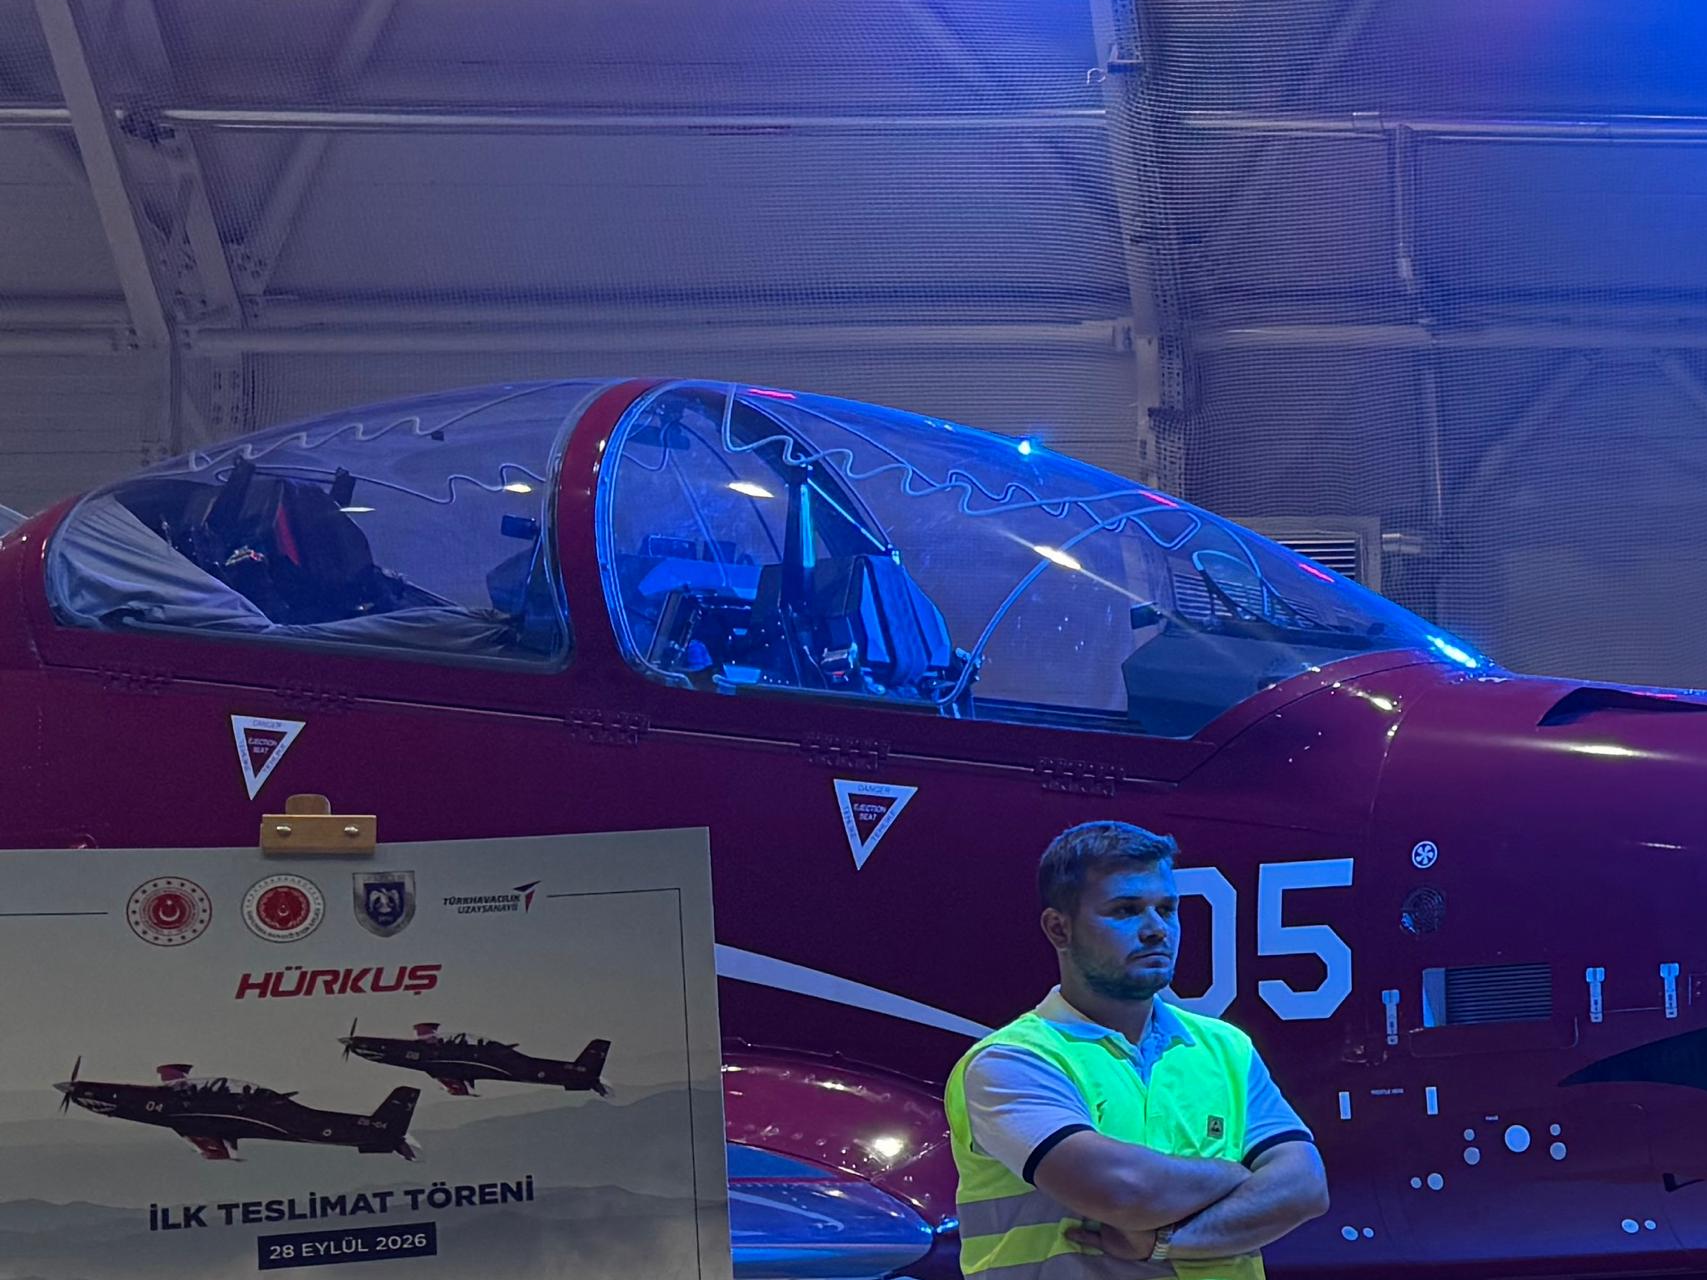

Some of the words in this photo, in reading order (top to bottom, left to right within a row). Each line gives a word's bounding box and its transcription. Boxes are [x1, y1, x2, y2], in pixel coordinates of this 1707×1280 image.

[1166, 858, 1354, 1020] 05
[235, 964, 442, 999] HÜRKUŞ
[145, 1100, 164, 1113] 04
[149, 1204, 207, 1231] İLK
[217, 1191, 395, 1225] TESLİMAT
[404, 1175, 534, 1211] TÖRENİ
[269, 1245, 295, 1260] 28
[301, 1237, 369, 1257] EYLÜL
[375, 1233, 427, 1251] 2026
